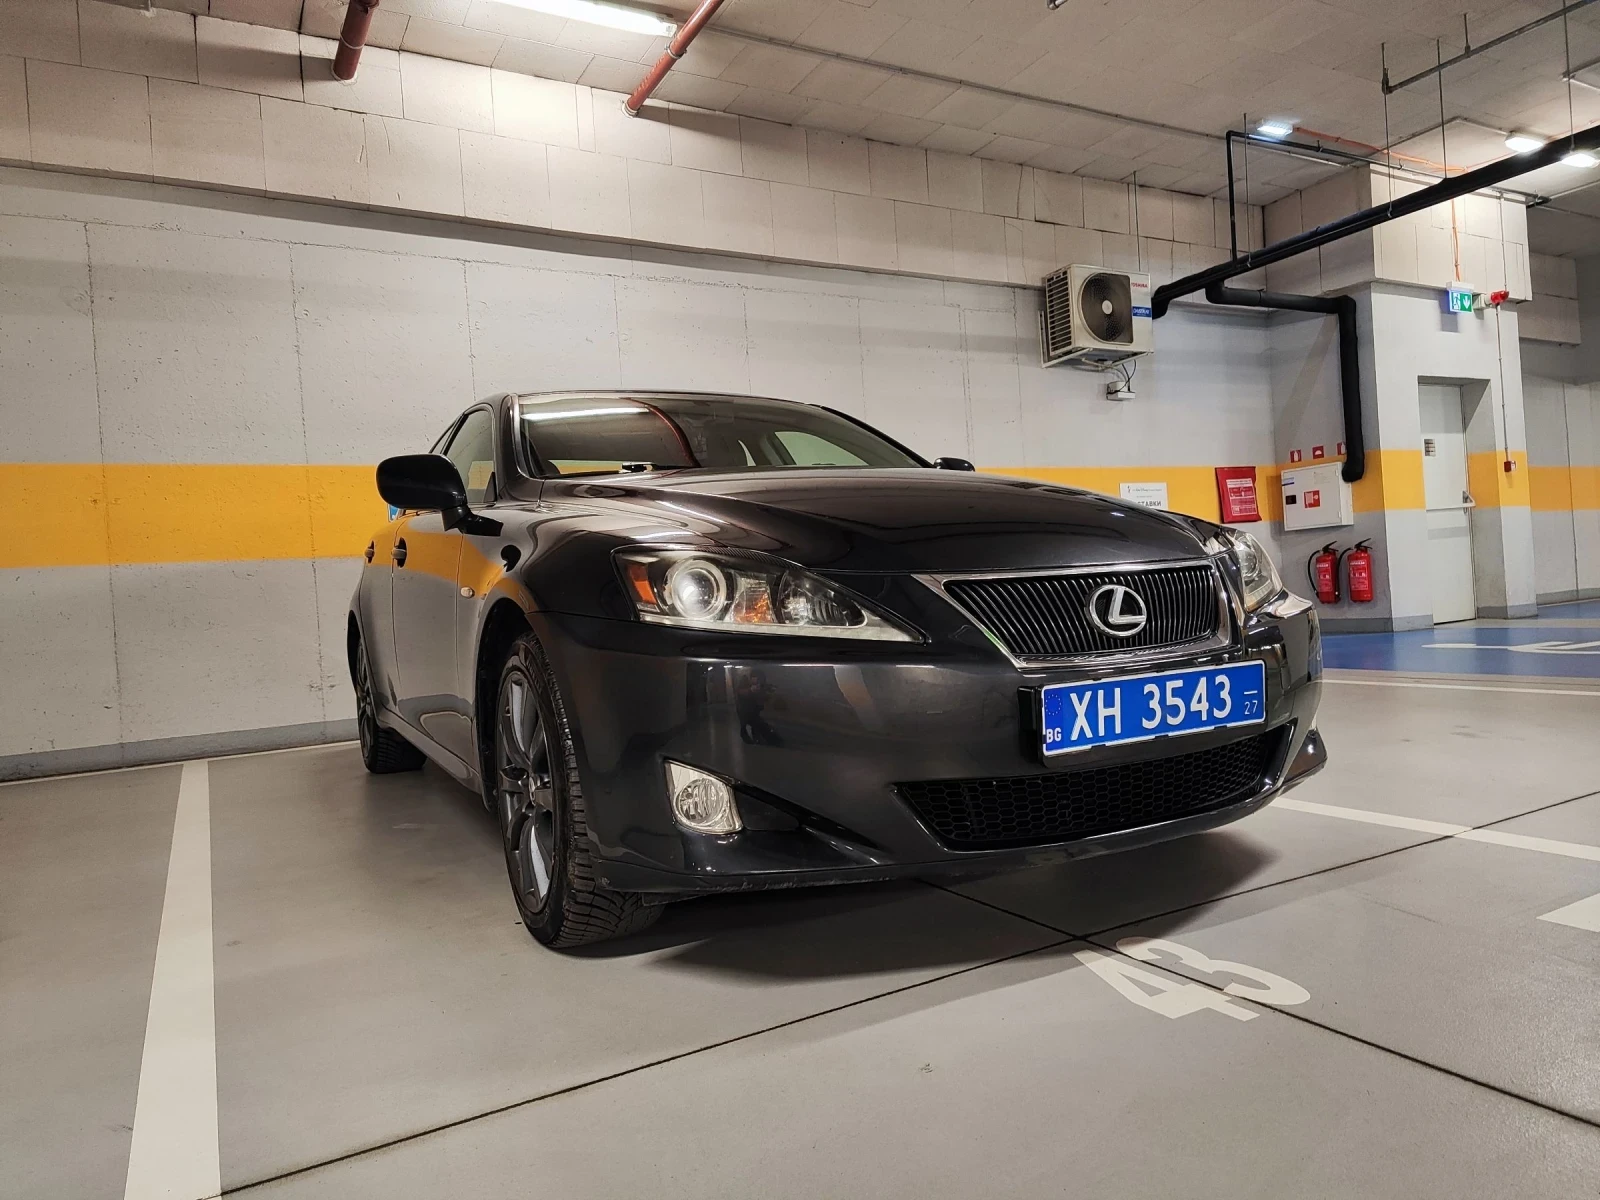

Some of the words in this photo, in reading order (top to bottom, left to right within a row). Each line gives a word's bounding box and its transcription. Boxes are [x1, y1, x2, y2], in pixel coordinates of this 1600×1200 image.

[1069, 687, 1122, 741] XH
[1141, 674, 1233, 730] 3543
[1244, 700, 1259, 715] 27
[1046, 727, 1062, 744] BG
[1072, 936, 1311, 1022] 43
